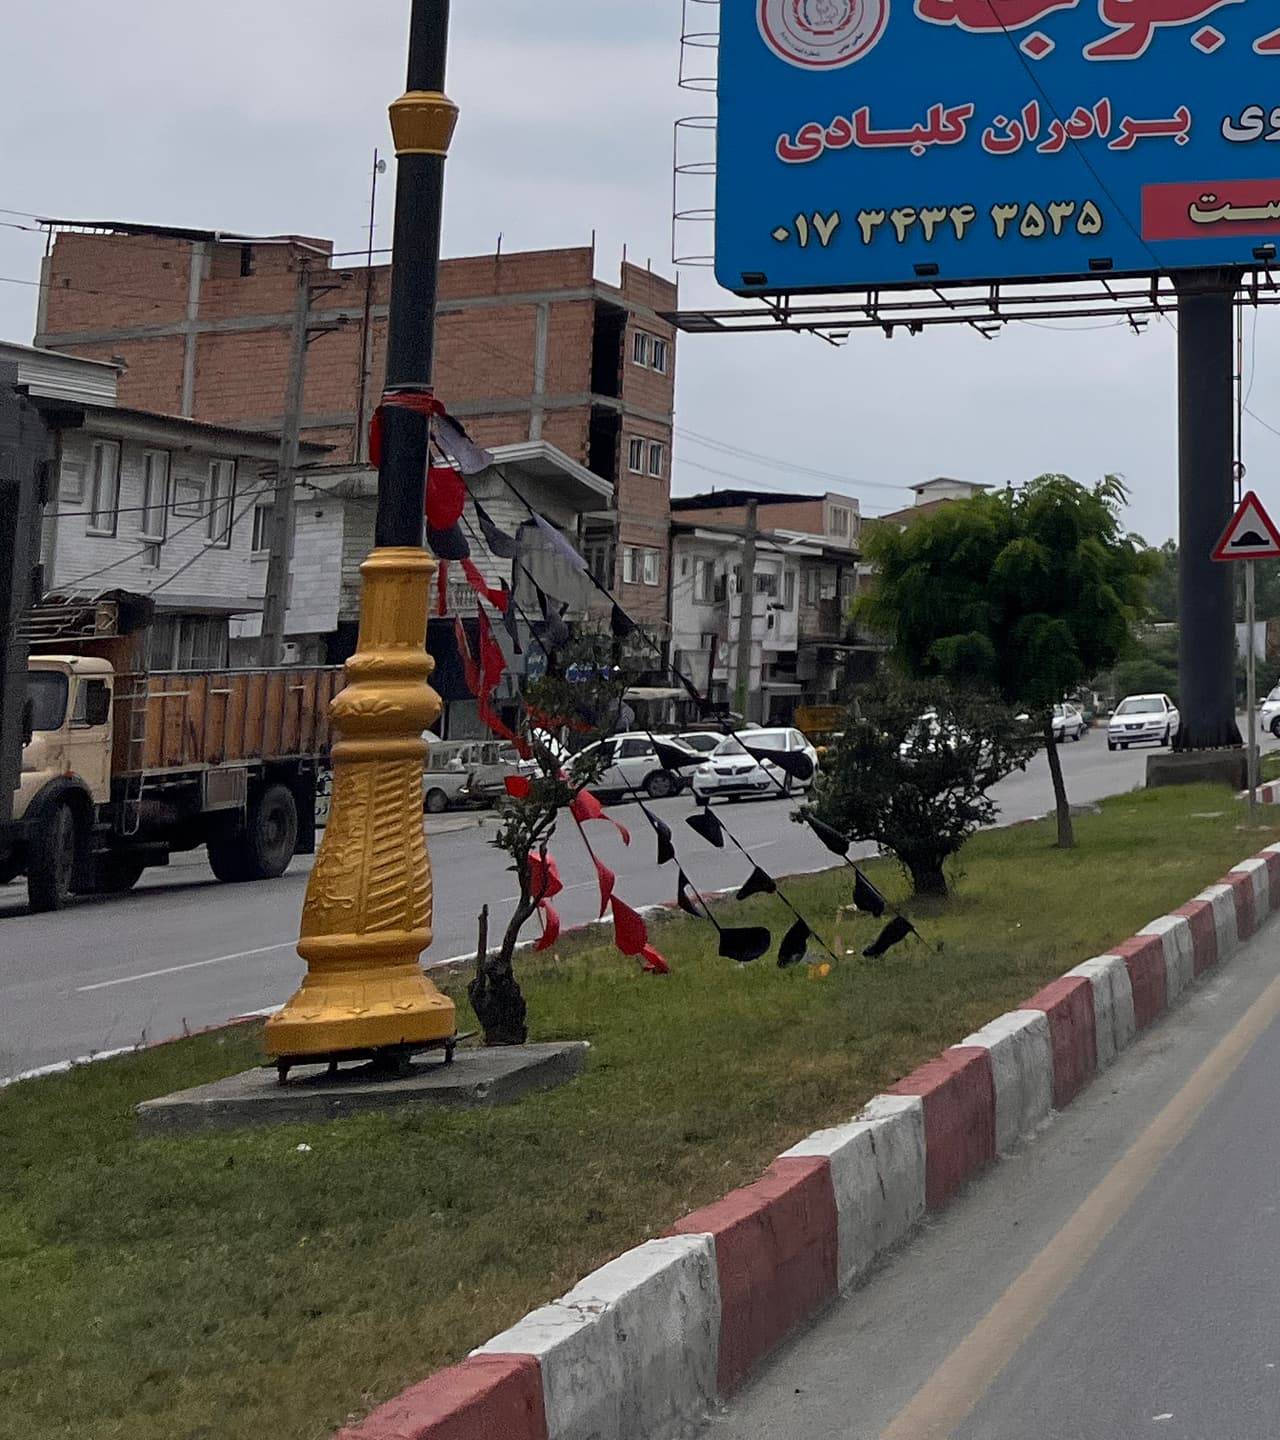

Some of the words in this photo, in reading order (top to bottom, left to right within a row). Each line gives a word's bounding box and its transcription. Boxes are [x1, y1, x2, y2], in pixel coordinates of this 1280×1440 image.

[775, 102, 974, 164] کلبادی
[982, 97, 1191, 154] برادران
[771, 210, 840, 248] ۰۱۷
[856, 203, 977, 245] ۳۴۳۴
[990, 199, 1104, 239] ۳۵۳۵
